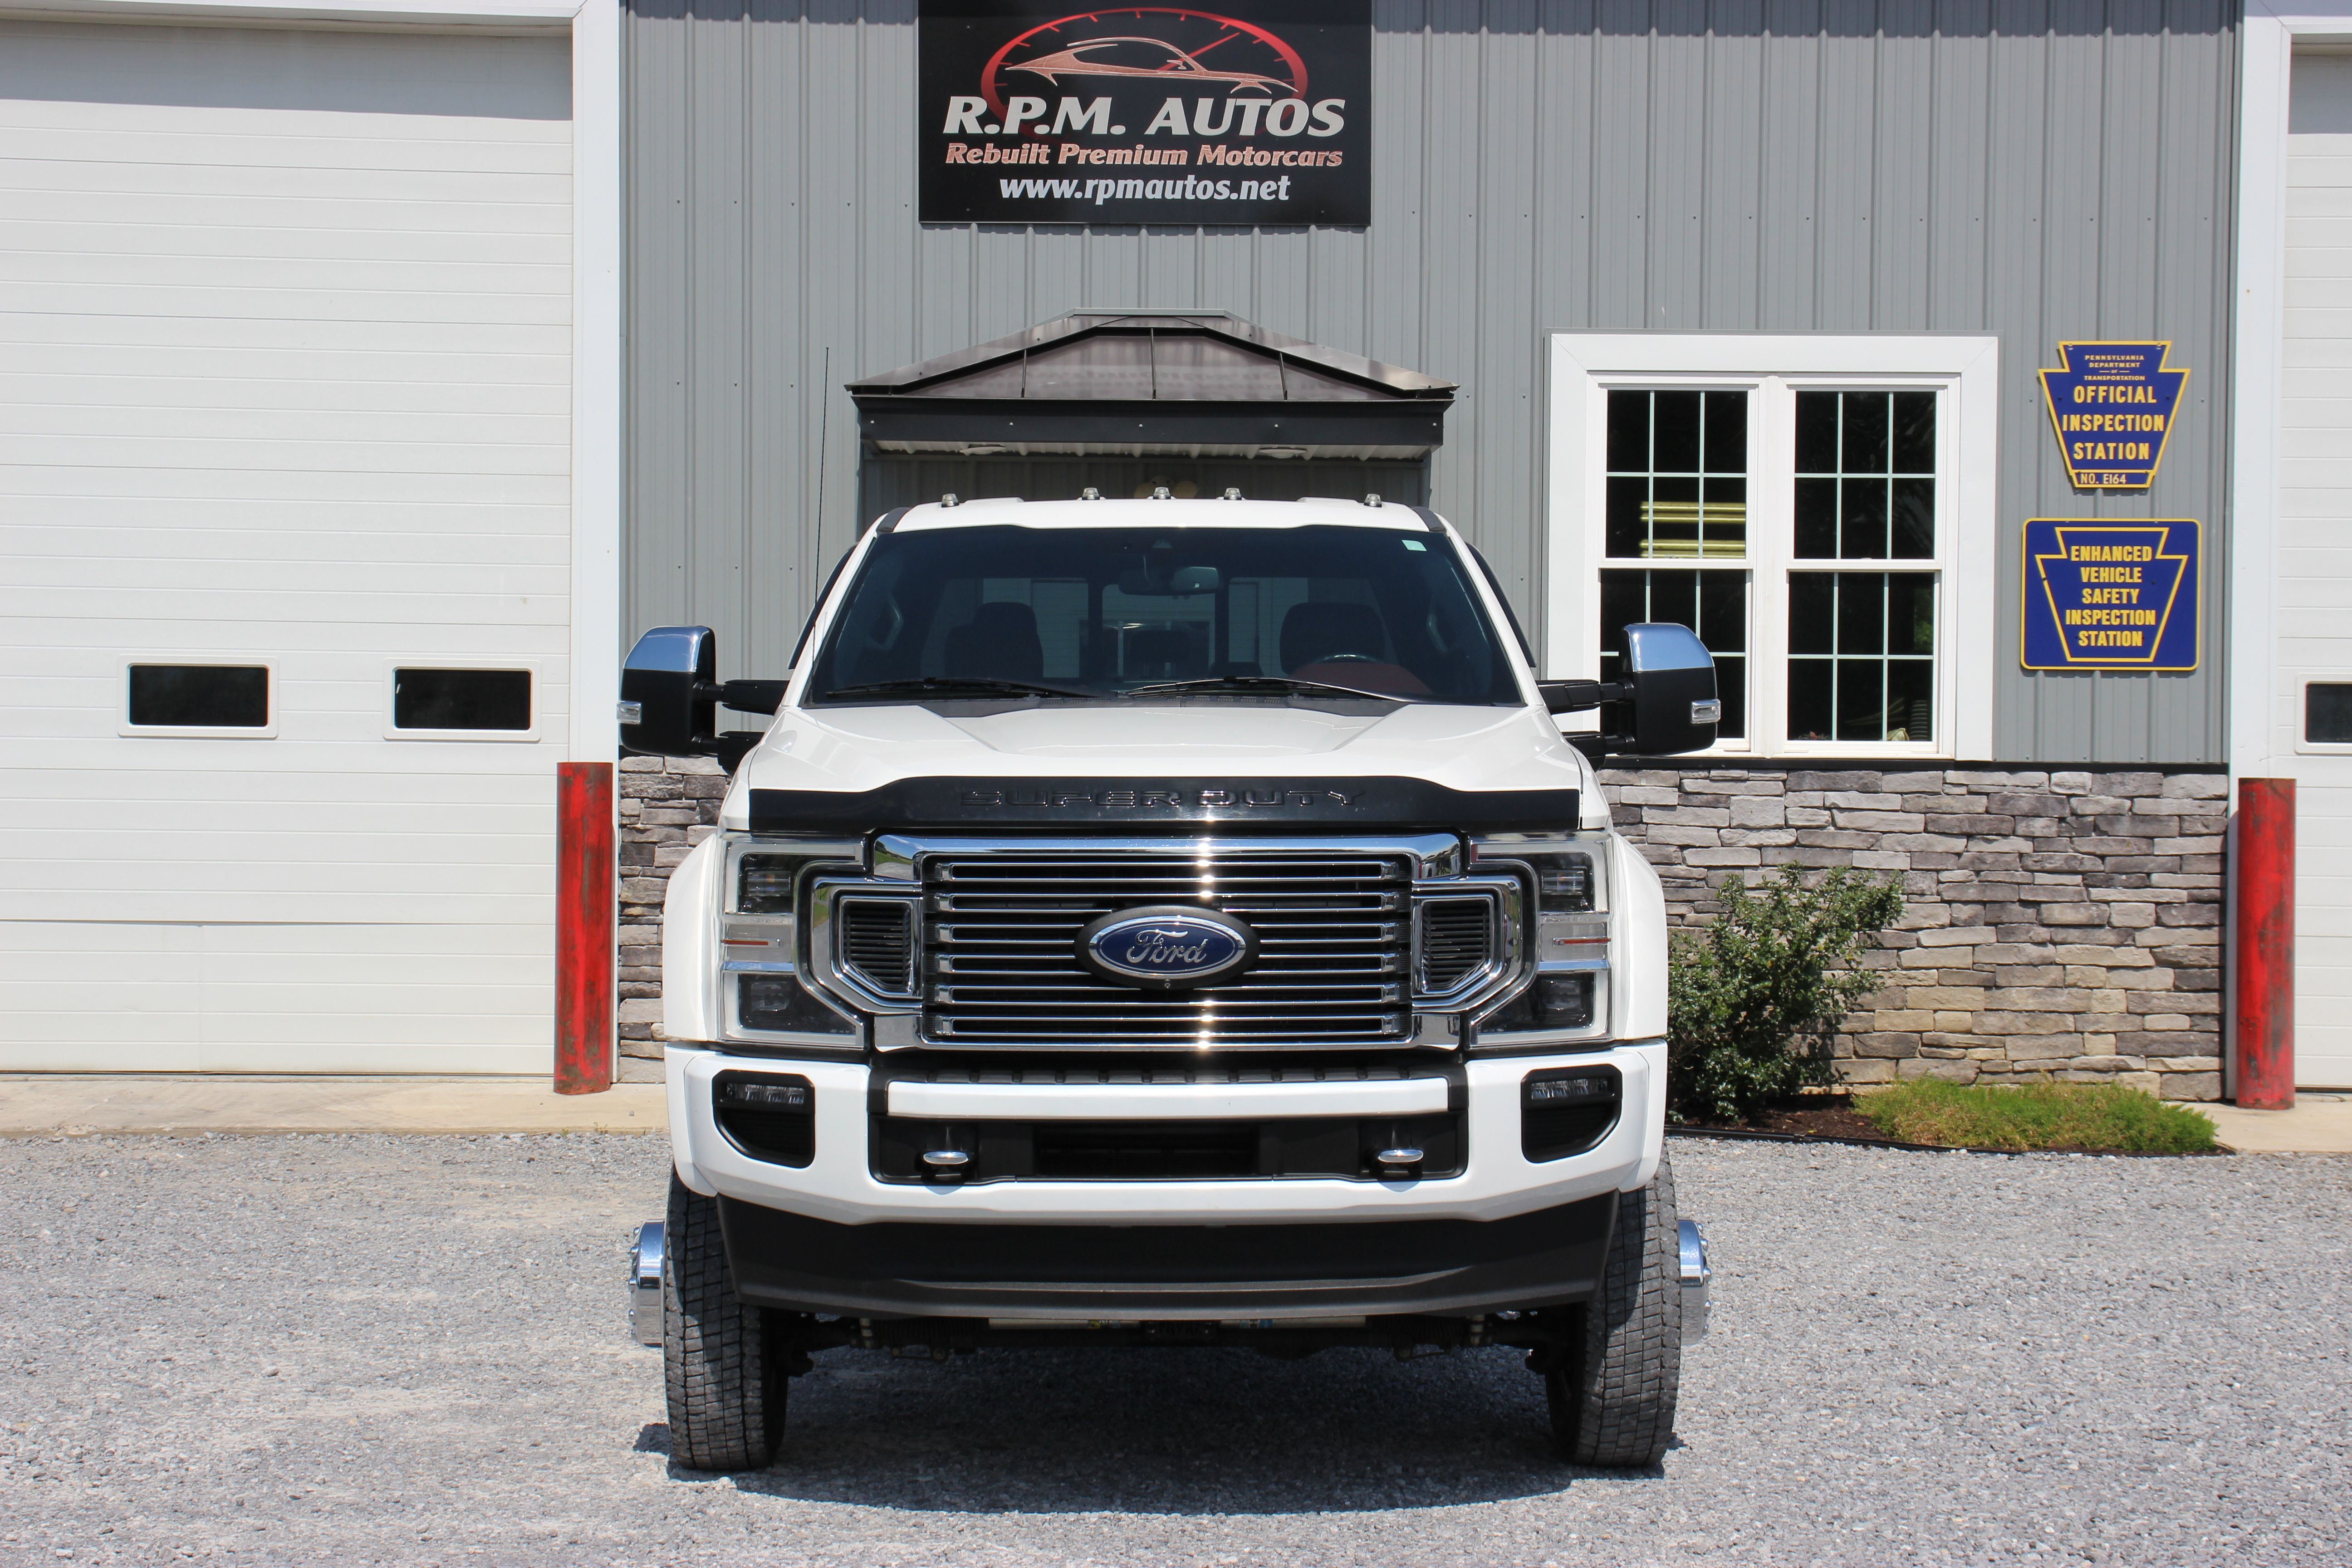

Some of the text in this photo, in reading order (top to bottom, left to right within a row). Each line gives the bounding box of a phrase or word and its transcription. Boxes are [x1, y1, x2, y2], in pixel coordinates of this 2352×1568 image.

[943, 96, 1346, 137] R.P.M. AUTOS
[946, 143, 1343, 167] Rebuilt Premium Motorcars
[999, 175, 1291, 205] www.rpmautos.net
[2073, 386, 2157, 403] OFFICIAL
[2062, 414, 2164, 431] INSPECTION
[2073, 442, 2150, 460] STATION
[2081, 473, 2127, 484] NO. E164
[2070, 545, 2152, 562] ENHANCED
[2080, 567, 2142, 583] VEHICLE
[2082, 588, 2140, 604] SAFETY
[2065, 609, 2156, 625] INSPECTION
[2078, 631, 2143, 647] STATION
[961, 789, 1366, 808] SUPER DUTY
[1126, 929, 1209, 963] Ford
